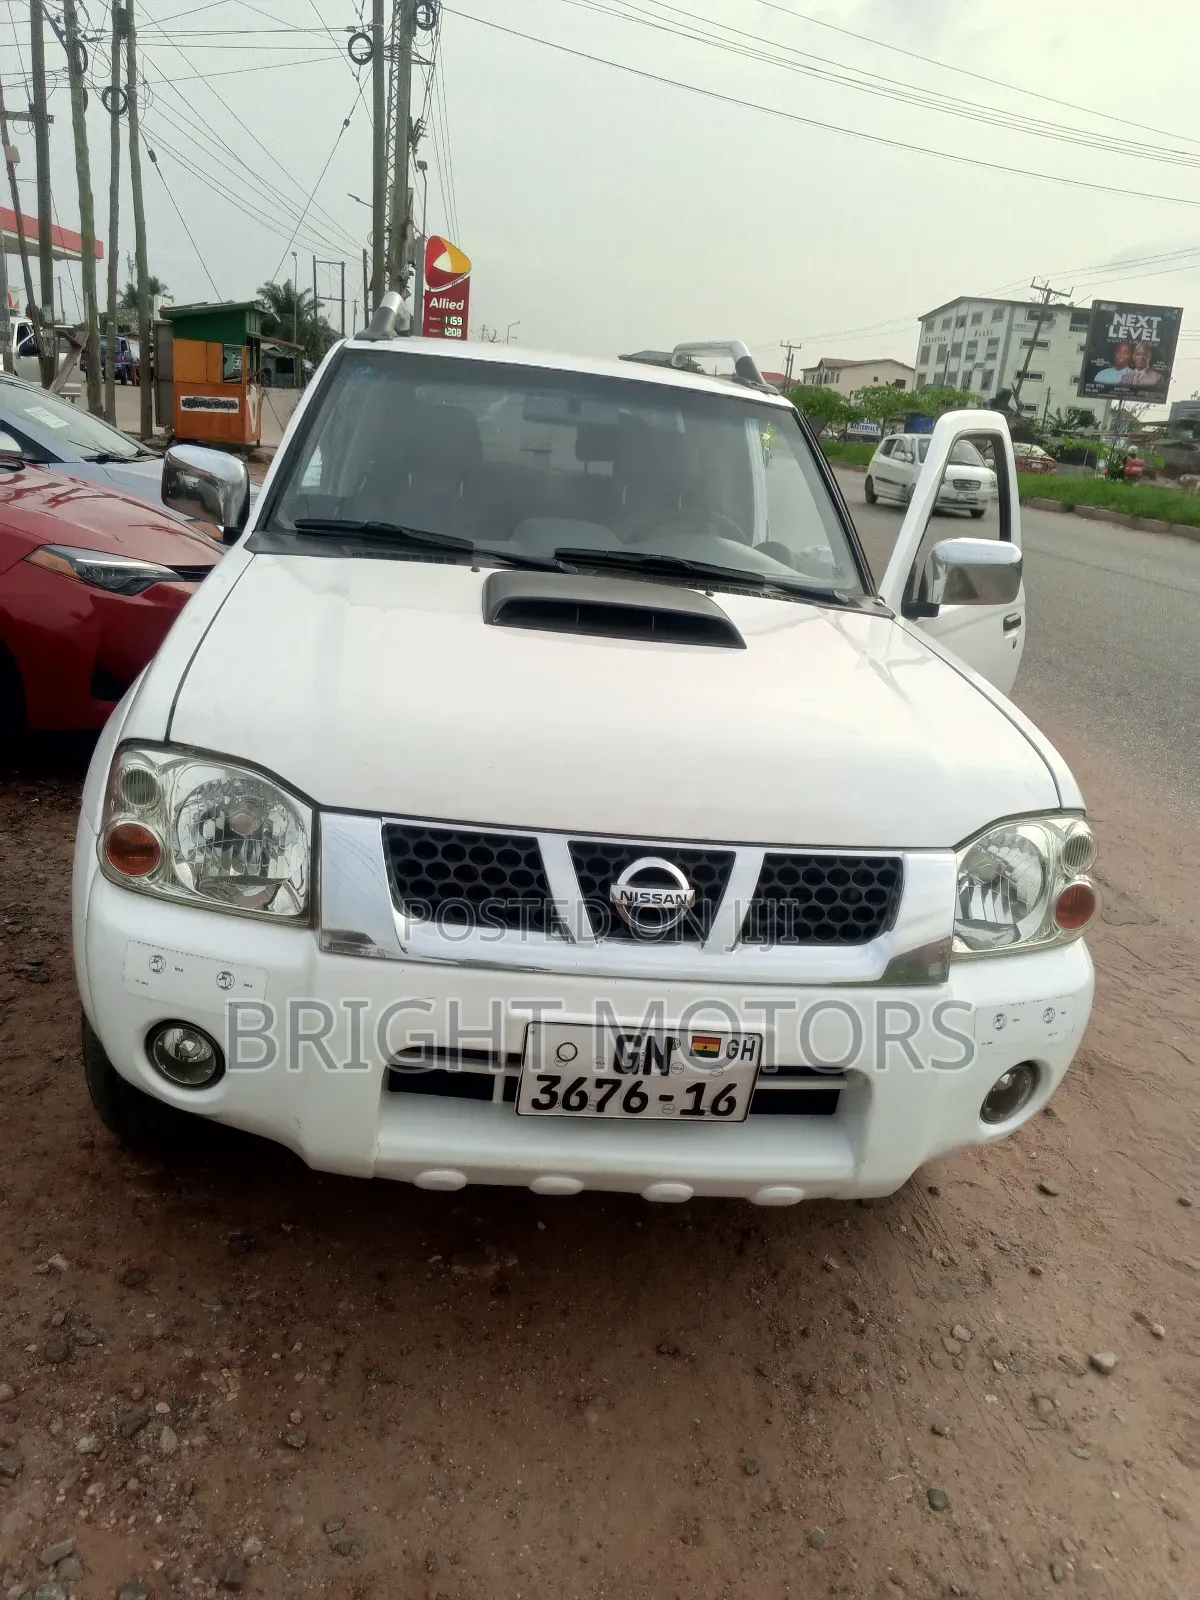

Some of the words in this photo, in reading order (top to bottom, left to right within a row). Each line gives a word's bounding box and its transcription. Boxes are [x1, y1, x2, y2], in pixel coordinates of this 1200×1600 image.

[429, 297, 464, 310] Allied
[1113, 312, 1161, 328] NEXT
[1108, 325, 1160, 342] LEVEL
[620, 890, 688, 905] NISSAN
[613, 1034, 674, 1077] GN
[725, 1039, 756, 1062] GH
[531, 1074, 738, 1117] 3676-16
